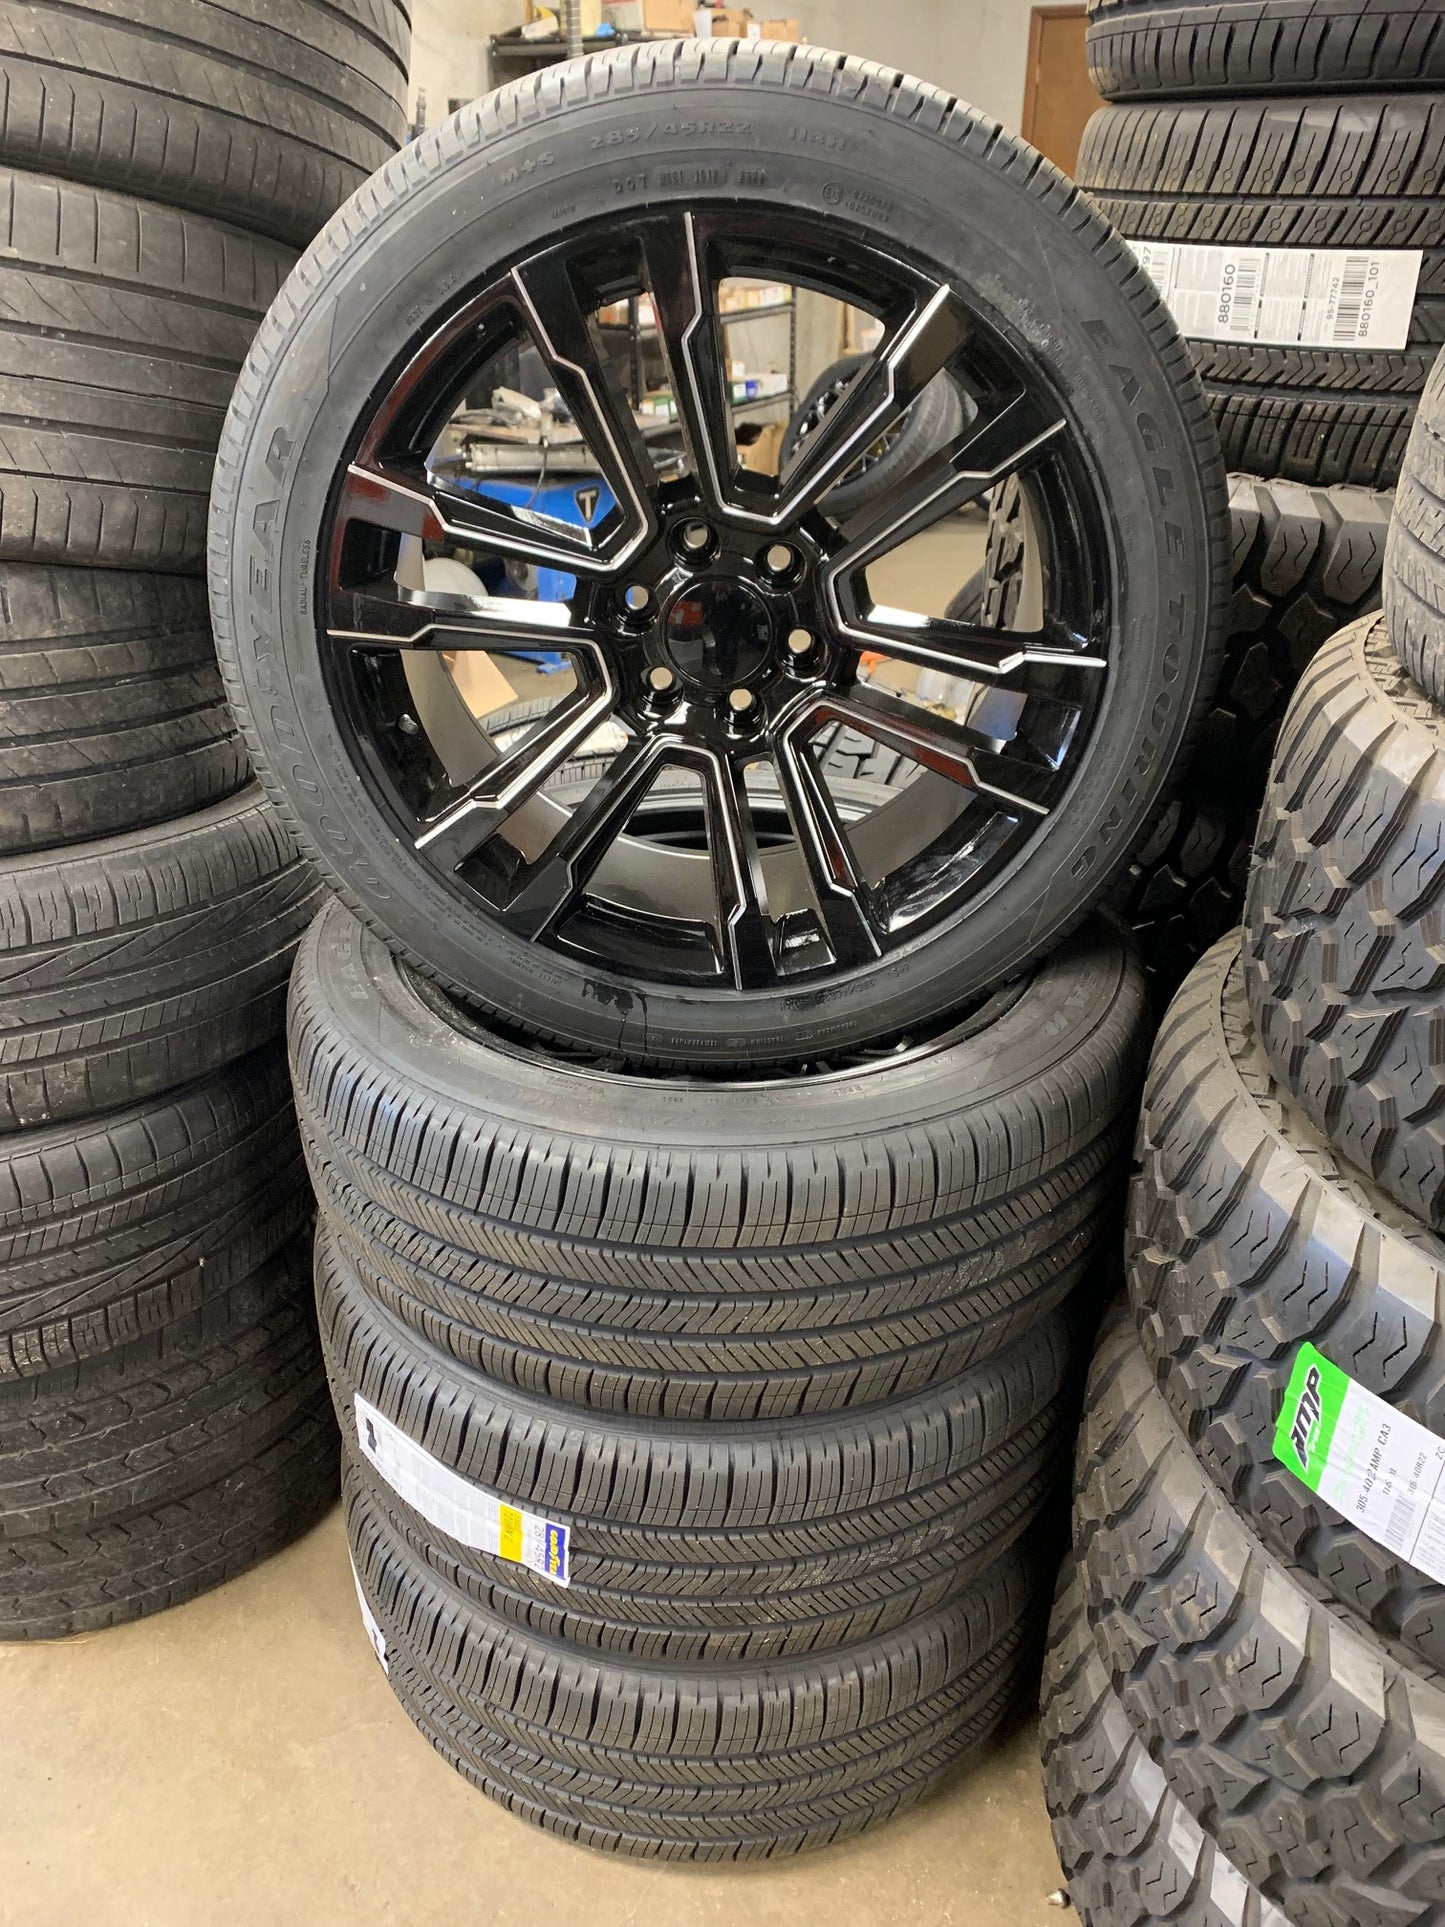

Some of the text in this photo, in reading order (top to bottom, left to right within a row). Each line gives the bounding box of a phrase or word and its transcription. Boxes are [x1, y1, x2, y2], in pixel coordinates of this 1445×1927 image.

[589, 119, 754, 150] 285/45R22
[1218, 264, 1236, 323] 880160
[1326, 276, 1340, 320] 95-77742
[1358, 261, 1380, 337] 880160_101
[1080, 318, 1186, 569] EAGLE
[248, 426, 393, 901] GOODYEAR
[1071, 592, 1188, 881] TOURING
